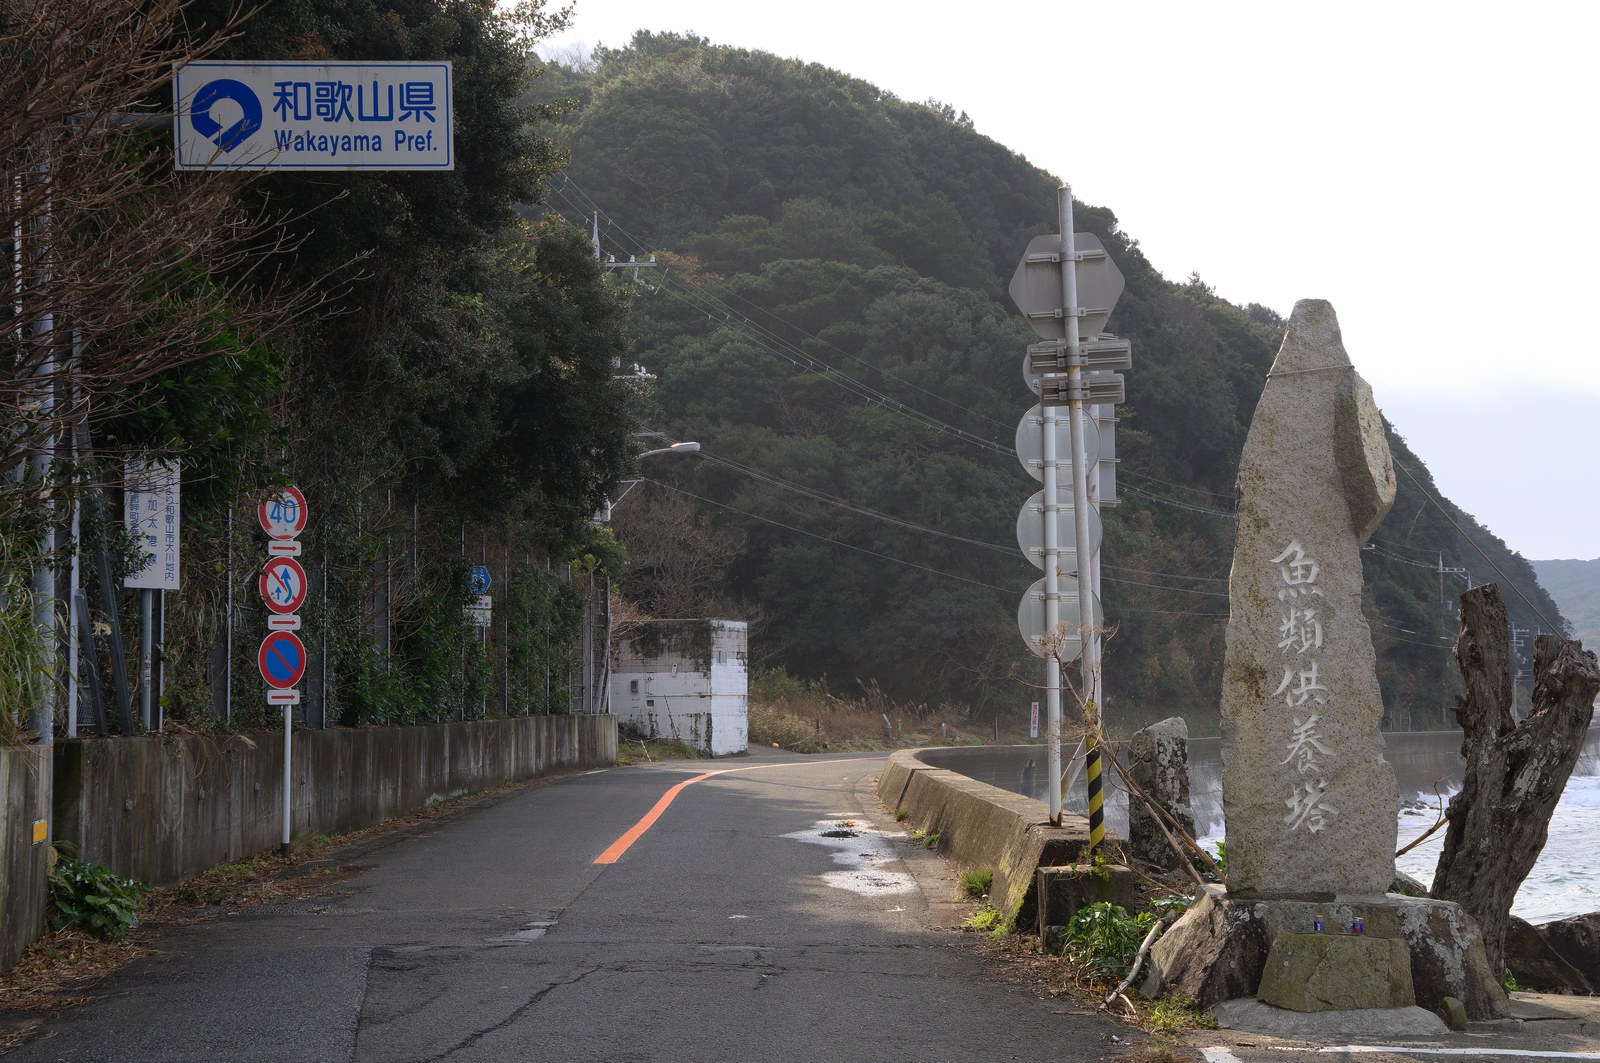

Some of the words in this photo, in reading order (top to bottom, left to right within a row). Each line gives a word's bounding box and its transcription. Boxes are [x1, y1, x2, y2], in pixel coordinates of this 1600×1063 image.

[273, 80, 437, 123] 和歌山県
[273, 129, 382, 156] Wakayama
[394, 130, 438, 152] Pref.
[164, 469, 175, 582] れより和歌山市大川地内
[270, 499, 296, 523] 40
[1269, 539, 1339, 833] 魚類供養塔
